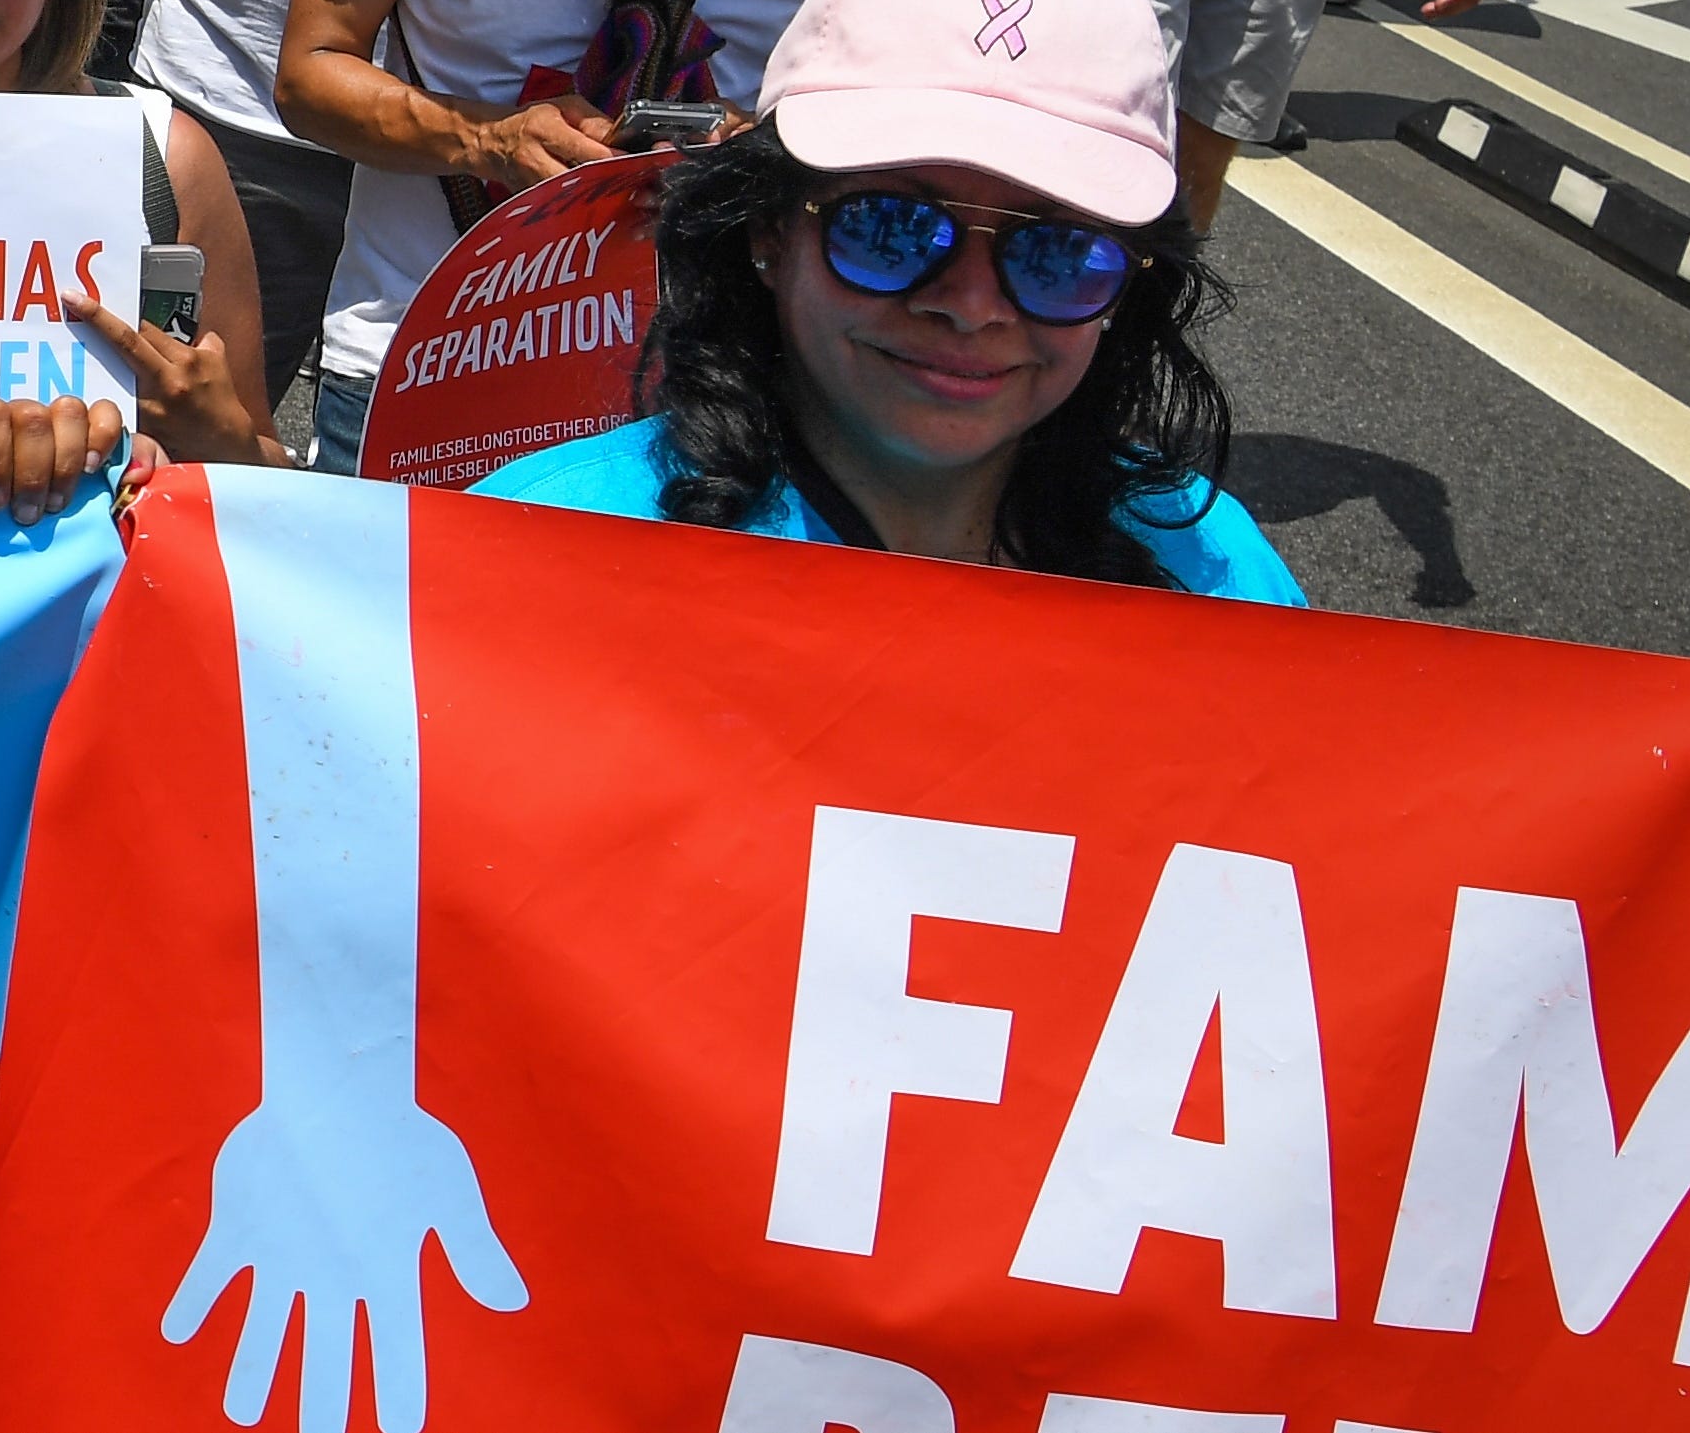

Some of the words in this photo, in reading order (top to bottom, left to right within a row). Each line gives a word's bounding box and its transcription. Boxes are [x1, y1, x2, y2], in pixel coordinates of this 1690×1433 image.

[181, 295, 195, 316] ISA
[445, 220, 616, 321] FAMILY
[394, 288, 635, 394] SEPARATION
